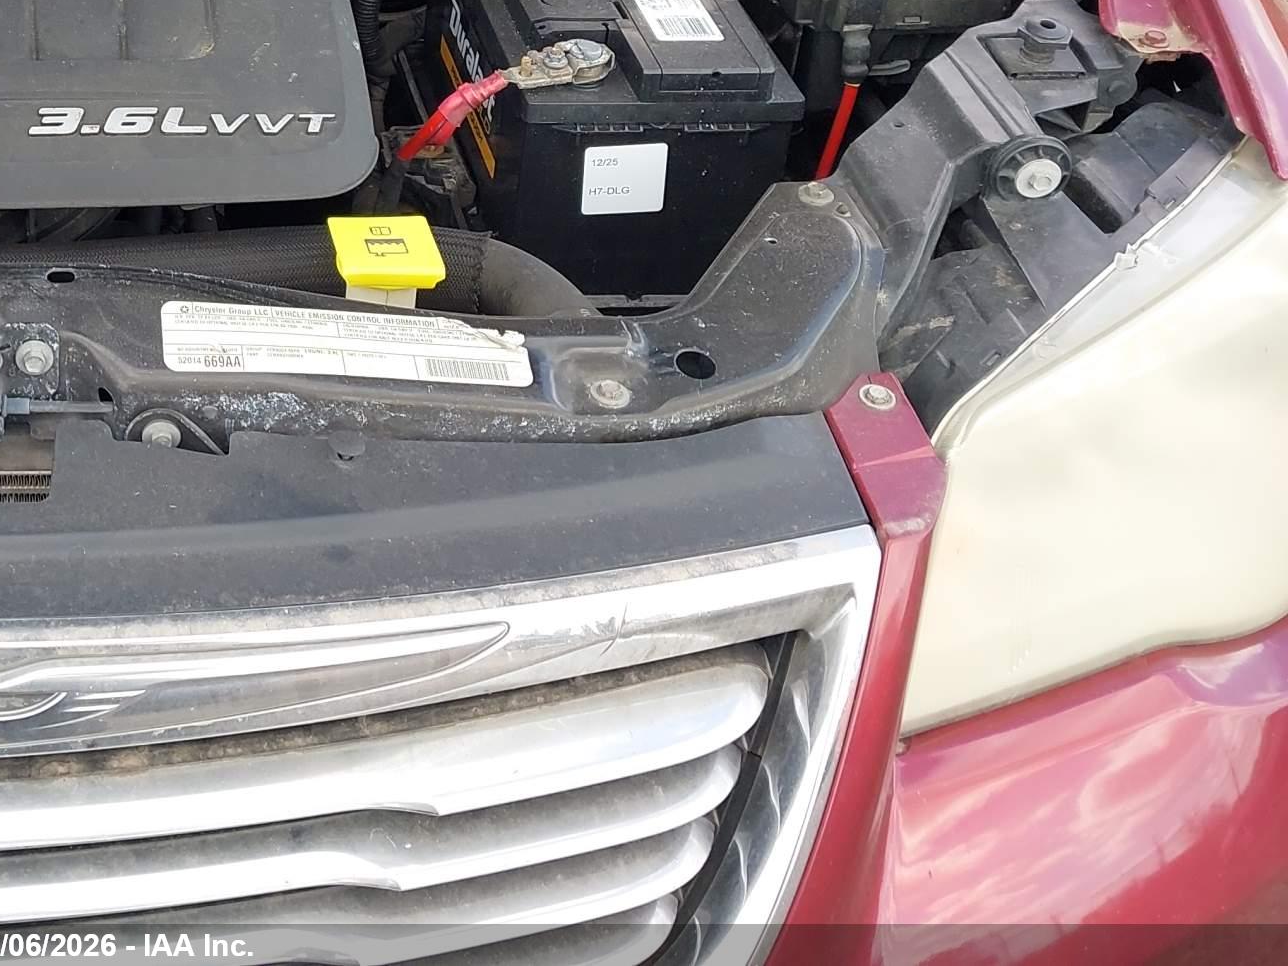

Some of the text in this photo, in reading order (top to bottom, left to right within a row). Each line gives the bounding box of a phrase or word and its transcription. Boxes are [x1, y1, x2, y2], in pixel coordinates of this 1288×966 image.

[28, 107, 336, 135] 3.6L VVT
[591, 158, 618, 167] 12/25
[588, 186, 630, 196] H7-DLG
[194, 304, 227, 316] Chrysler
[228, 306, 252, 317] Group
[254, 308, 269, 316] LLC
[274, 309, 306, 319] VEHICLE
[307, 311, 345, 321] EMISSION
[346, 314, 381, 324] CONTROL
[382, 316, 436, 328] INFORMATION
[203, 354, 242, 368] 669AA
